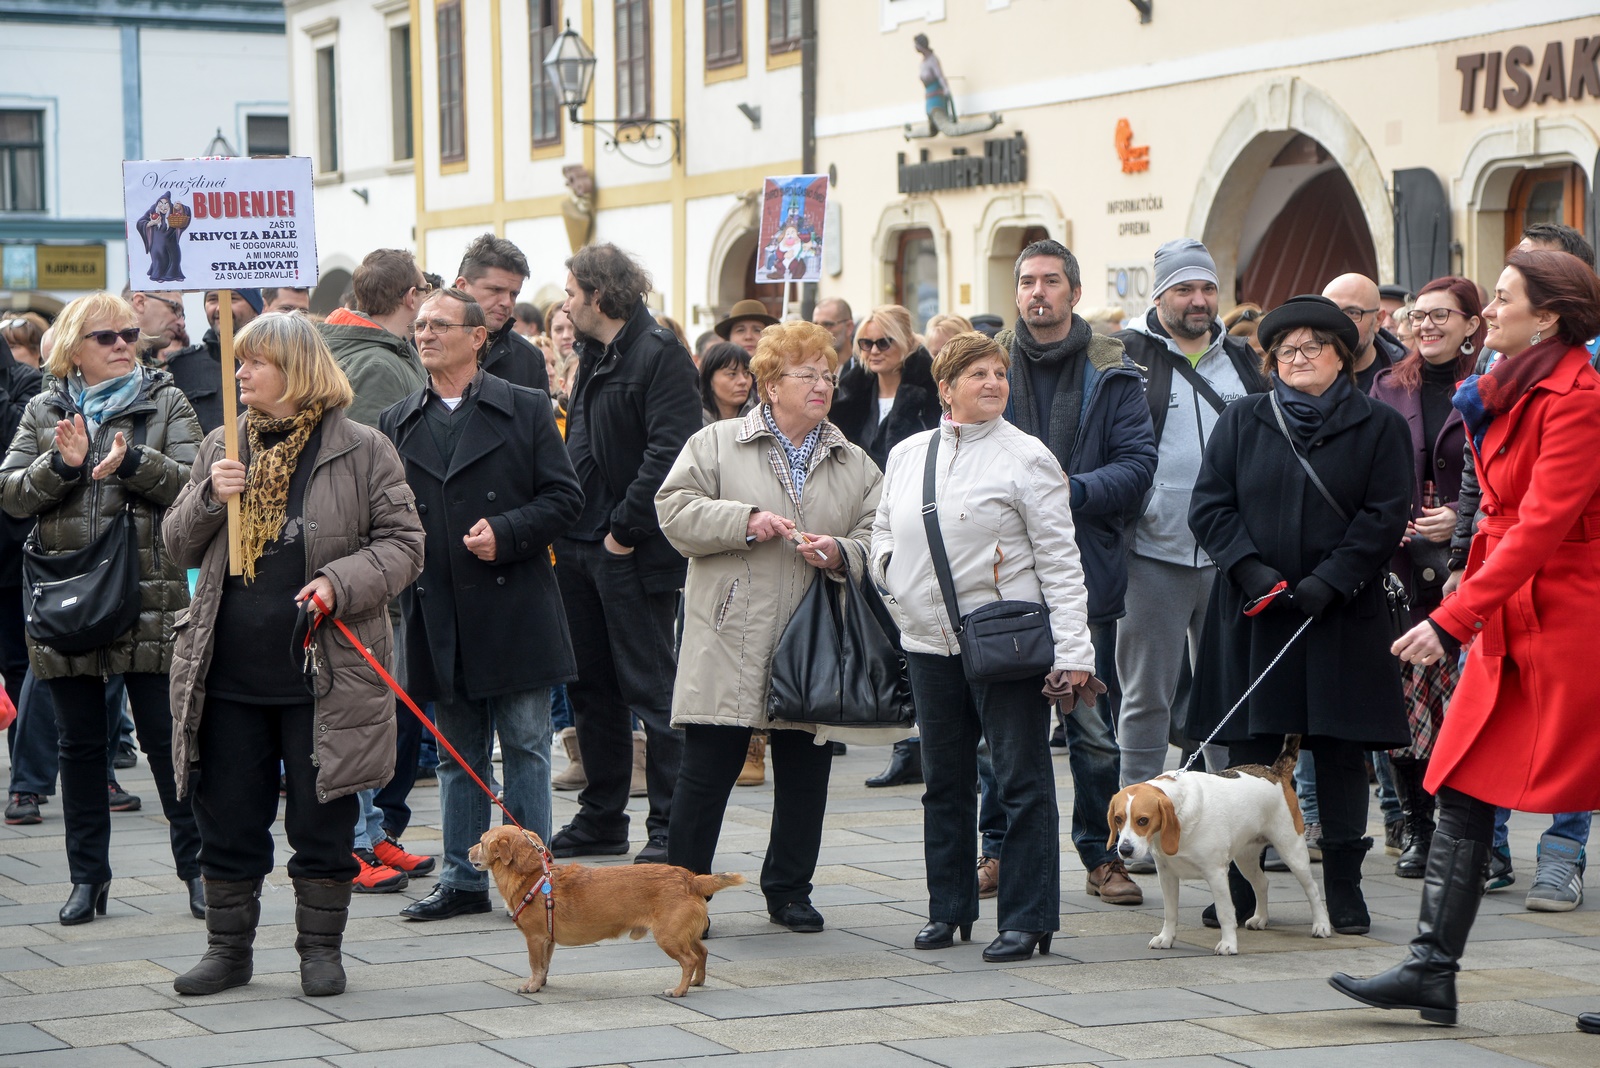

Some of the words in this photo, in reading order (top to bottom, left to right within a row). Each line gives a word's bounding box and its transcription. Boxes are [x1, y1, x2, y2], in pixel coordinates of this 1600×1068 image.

[1456, 35, 1600, 113] TISAK
[142, 169, 227, 197] Varaždinci
[192, 190, 296, 220] BUĐENJE!
[269, 220, 295, 229] ZAŠTO
[1119, 222, 1150, 236] OPREMA
[189, 231, 237, 241] KRIVCI
[240, 231, 259, 240] ZA
[262, 230, 297, 239] BALE
[242, 242, 298, 250] ODGOVARAJU,
[211, 260, 298, 271] STRAHOVATI
[1107, 267, 1148, 299] FOTO
